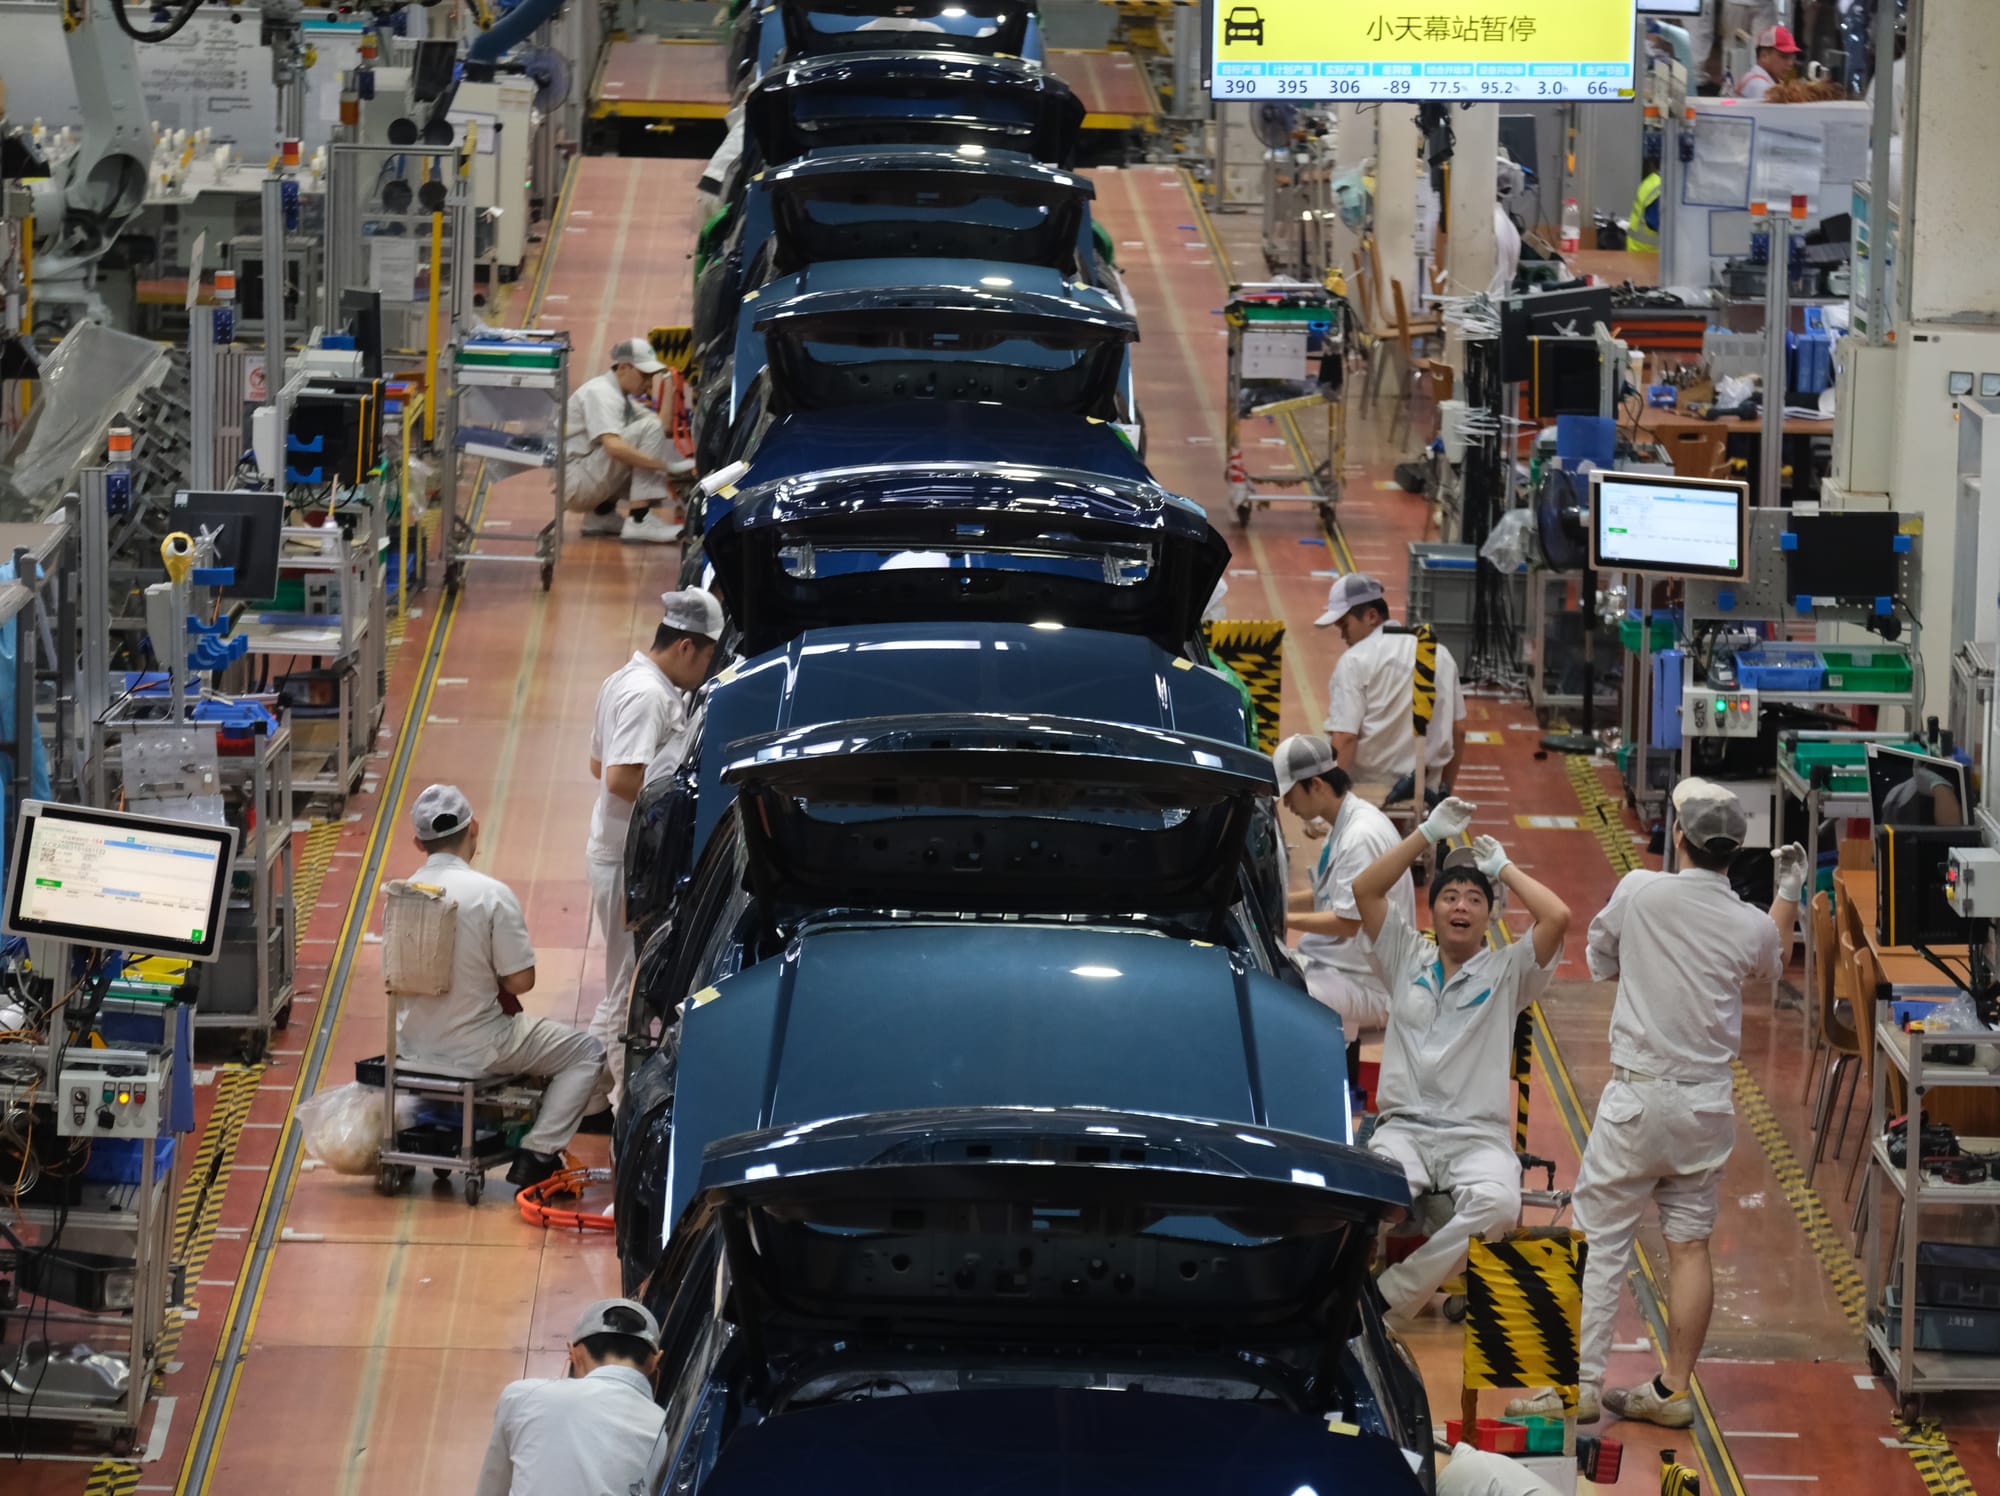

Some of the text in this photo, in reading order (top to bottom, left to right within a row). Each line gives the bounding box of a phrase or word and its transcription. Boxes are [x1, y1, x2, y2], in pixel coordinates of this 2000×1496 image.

[1366, 15, 1537, 42] 小天幕站暂停
[1225, 80, 1256, 94] 390
[1277, 80, 1308, 94] 395
[1329, 80, 1360, 94] 306
[1383, 80, 1410, 94] -89
